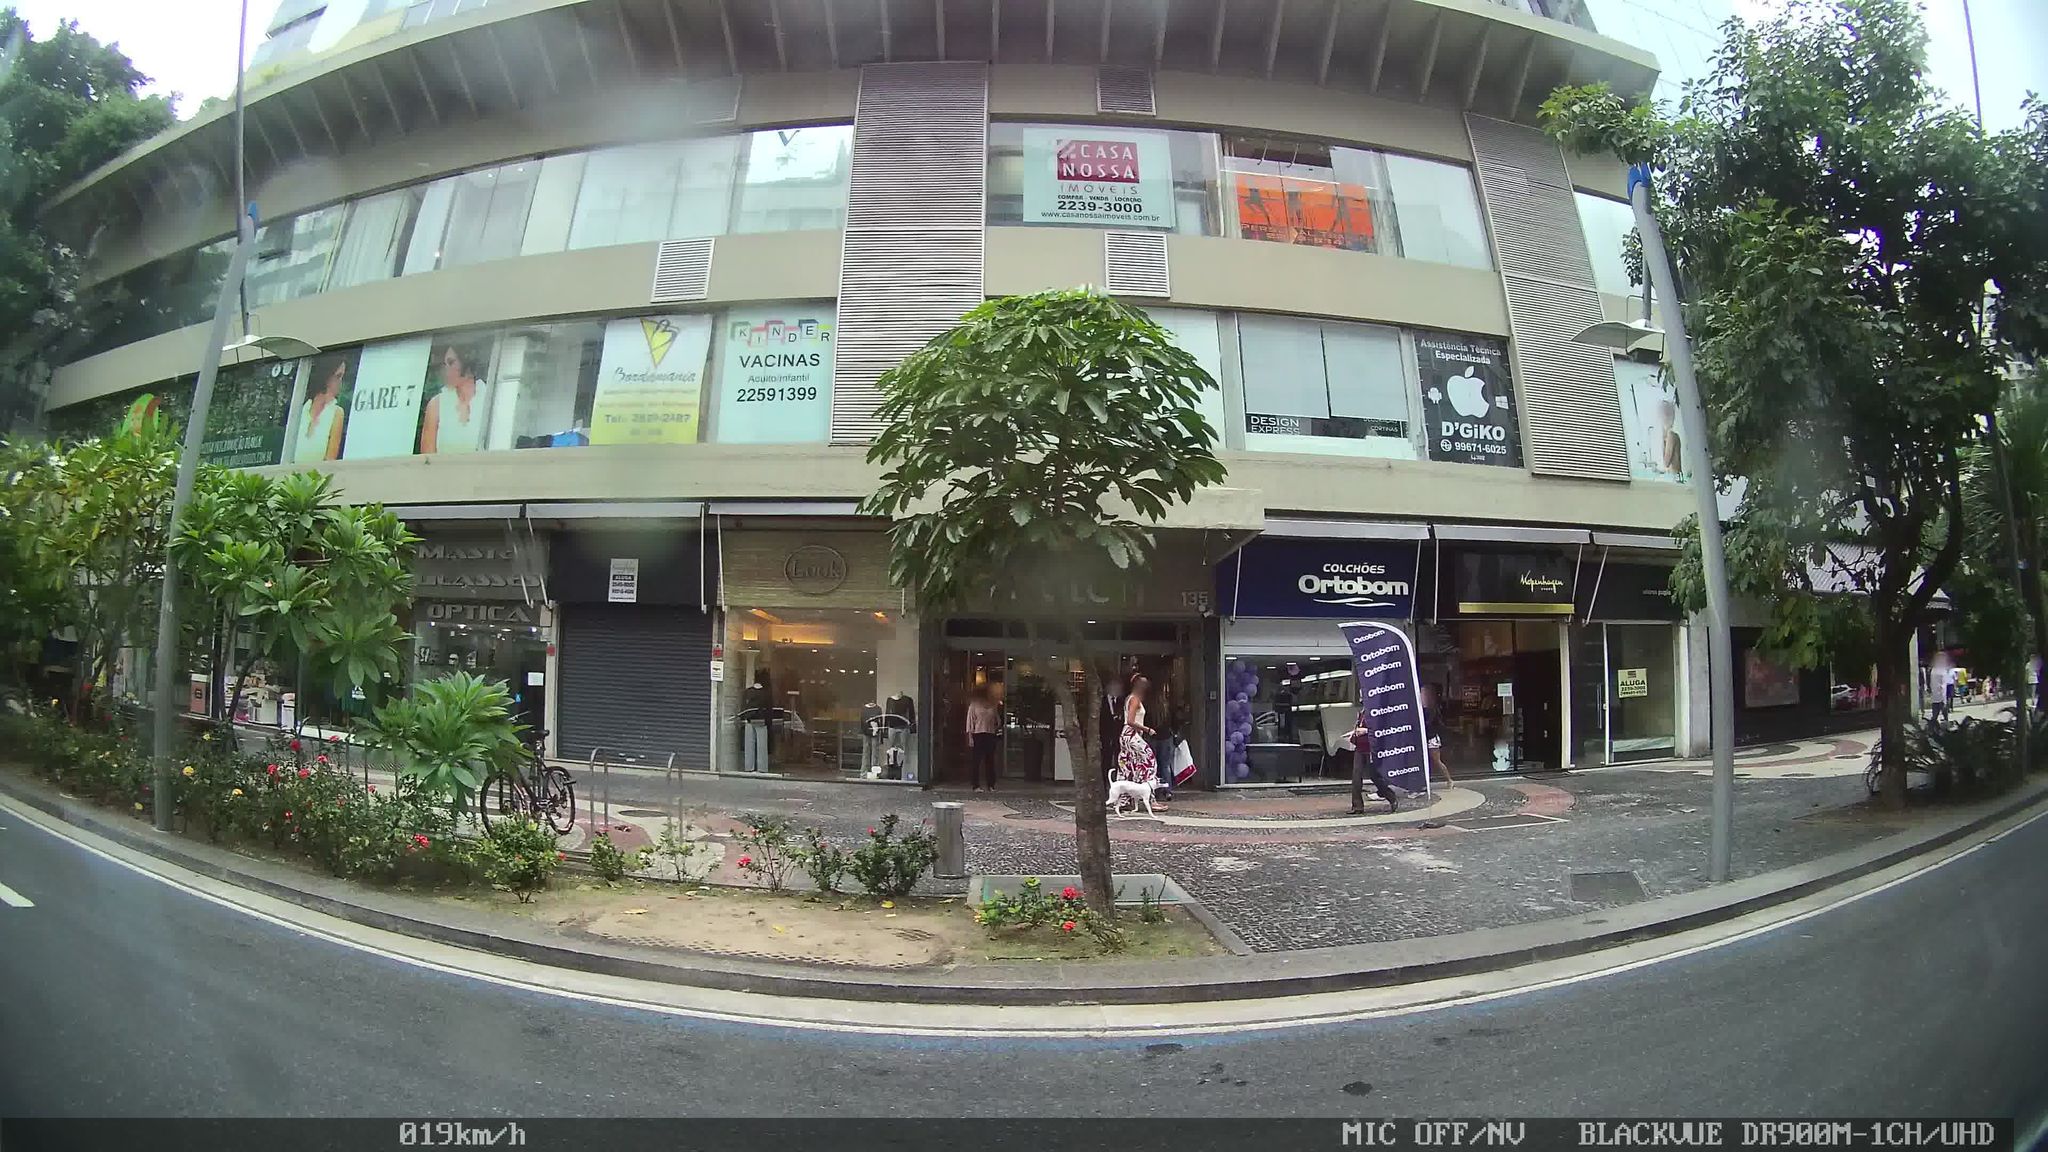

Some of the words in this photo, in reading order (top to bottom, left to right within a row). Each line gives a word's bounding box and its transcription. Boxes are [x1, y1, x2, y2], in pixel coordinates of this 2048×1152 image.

[1081, 143, 1134, 160] CASA
[1062, 162, 1136, 179] NOSSA
[1057, 200, 1143, 214] 2239-3000
[738, 324, 831, 345] KINDER
[1435, 350, 1491, 364] Especializada
[1470, 344, 1502, 356] Técnica
[739, 353, 821, 368] VACINAS
[354, 385, 401, 412] GARE
[405, 385, 416, 407] 7
[736, 386, 818, 402] 22591399
[1250, 415, 1300, 427] DESIGN
[1250, 425, 1300, 435] EXPRESS
[1454, 442, 1507, 454] 99671-6025
[1322, 562, 1386, 574] COLCHÕES
[1298, 574, 1409, 596] Ortobom
[1181, 591, 1209, 607] 135
[1353, 629, 1386, 644] Ortobom
[1360, 644, 1401, 662] Ortobom
[1364, 661, 1402, 678] Ortobom
[1367, 682, 1405, 698] Ortobom
[1620, 679, 1646, 687] ALUGA
[1370, 703, 1409, 717] Ortobom
[1374, 724, 1412, 738] Ortobom
[1377, 745, 1415, 759] Ortobom
[1387, 766, 1420, 777] Ortobom
